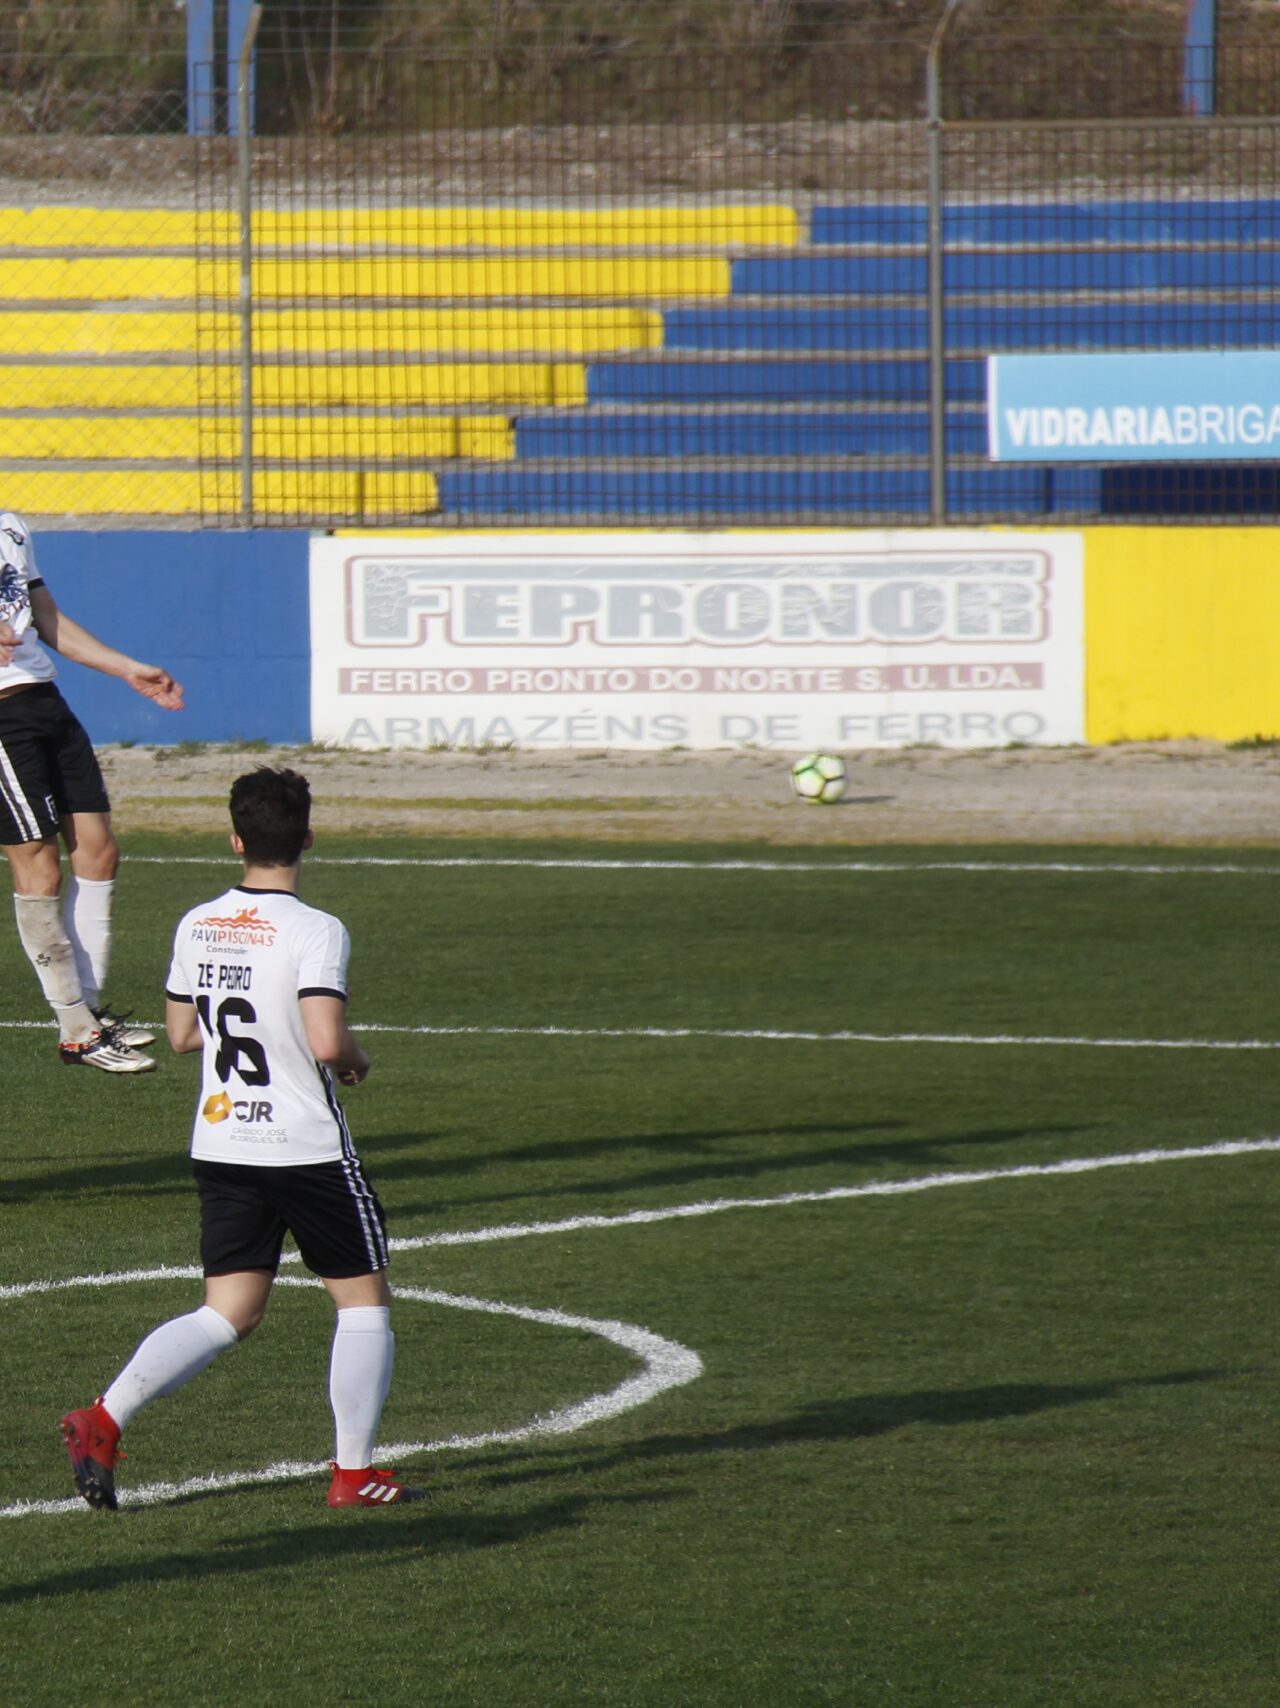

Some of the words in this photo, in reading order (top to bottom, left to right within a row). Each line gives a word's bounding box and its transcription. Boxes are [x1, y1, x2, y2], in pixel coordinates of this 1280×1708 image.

[363, 561, 1037, 639] FEPRONOR
[350, 668, 474, 693] FERRO
[486, 668, 636, 693] PRONTO
[648, 667, 702, 692] DO
[713, 667, 843, 692] NORTE
[855, 666, 890, 691] S.
[902, 665, 938, 690] U.
[947, 664, 1033, 690] LDA.
[343, 708, 690, 745] ARMAZÉNS
[720, 713, 801, 743] DE
[837, 710, 1048, 743] FERRO
[191, 928, 276, 948] PAVIPISCINAS
[197, 959, 215, 988] ZÉ
[195, 994, 271, 1087] 16
[233, 1100, 275, 1123] CJR
